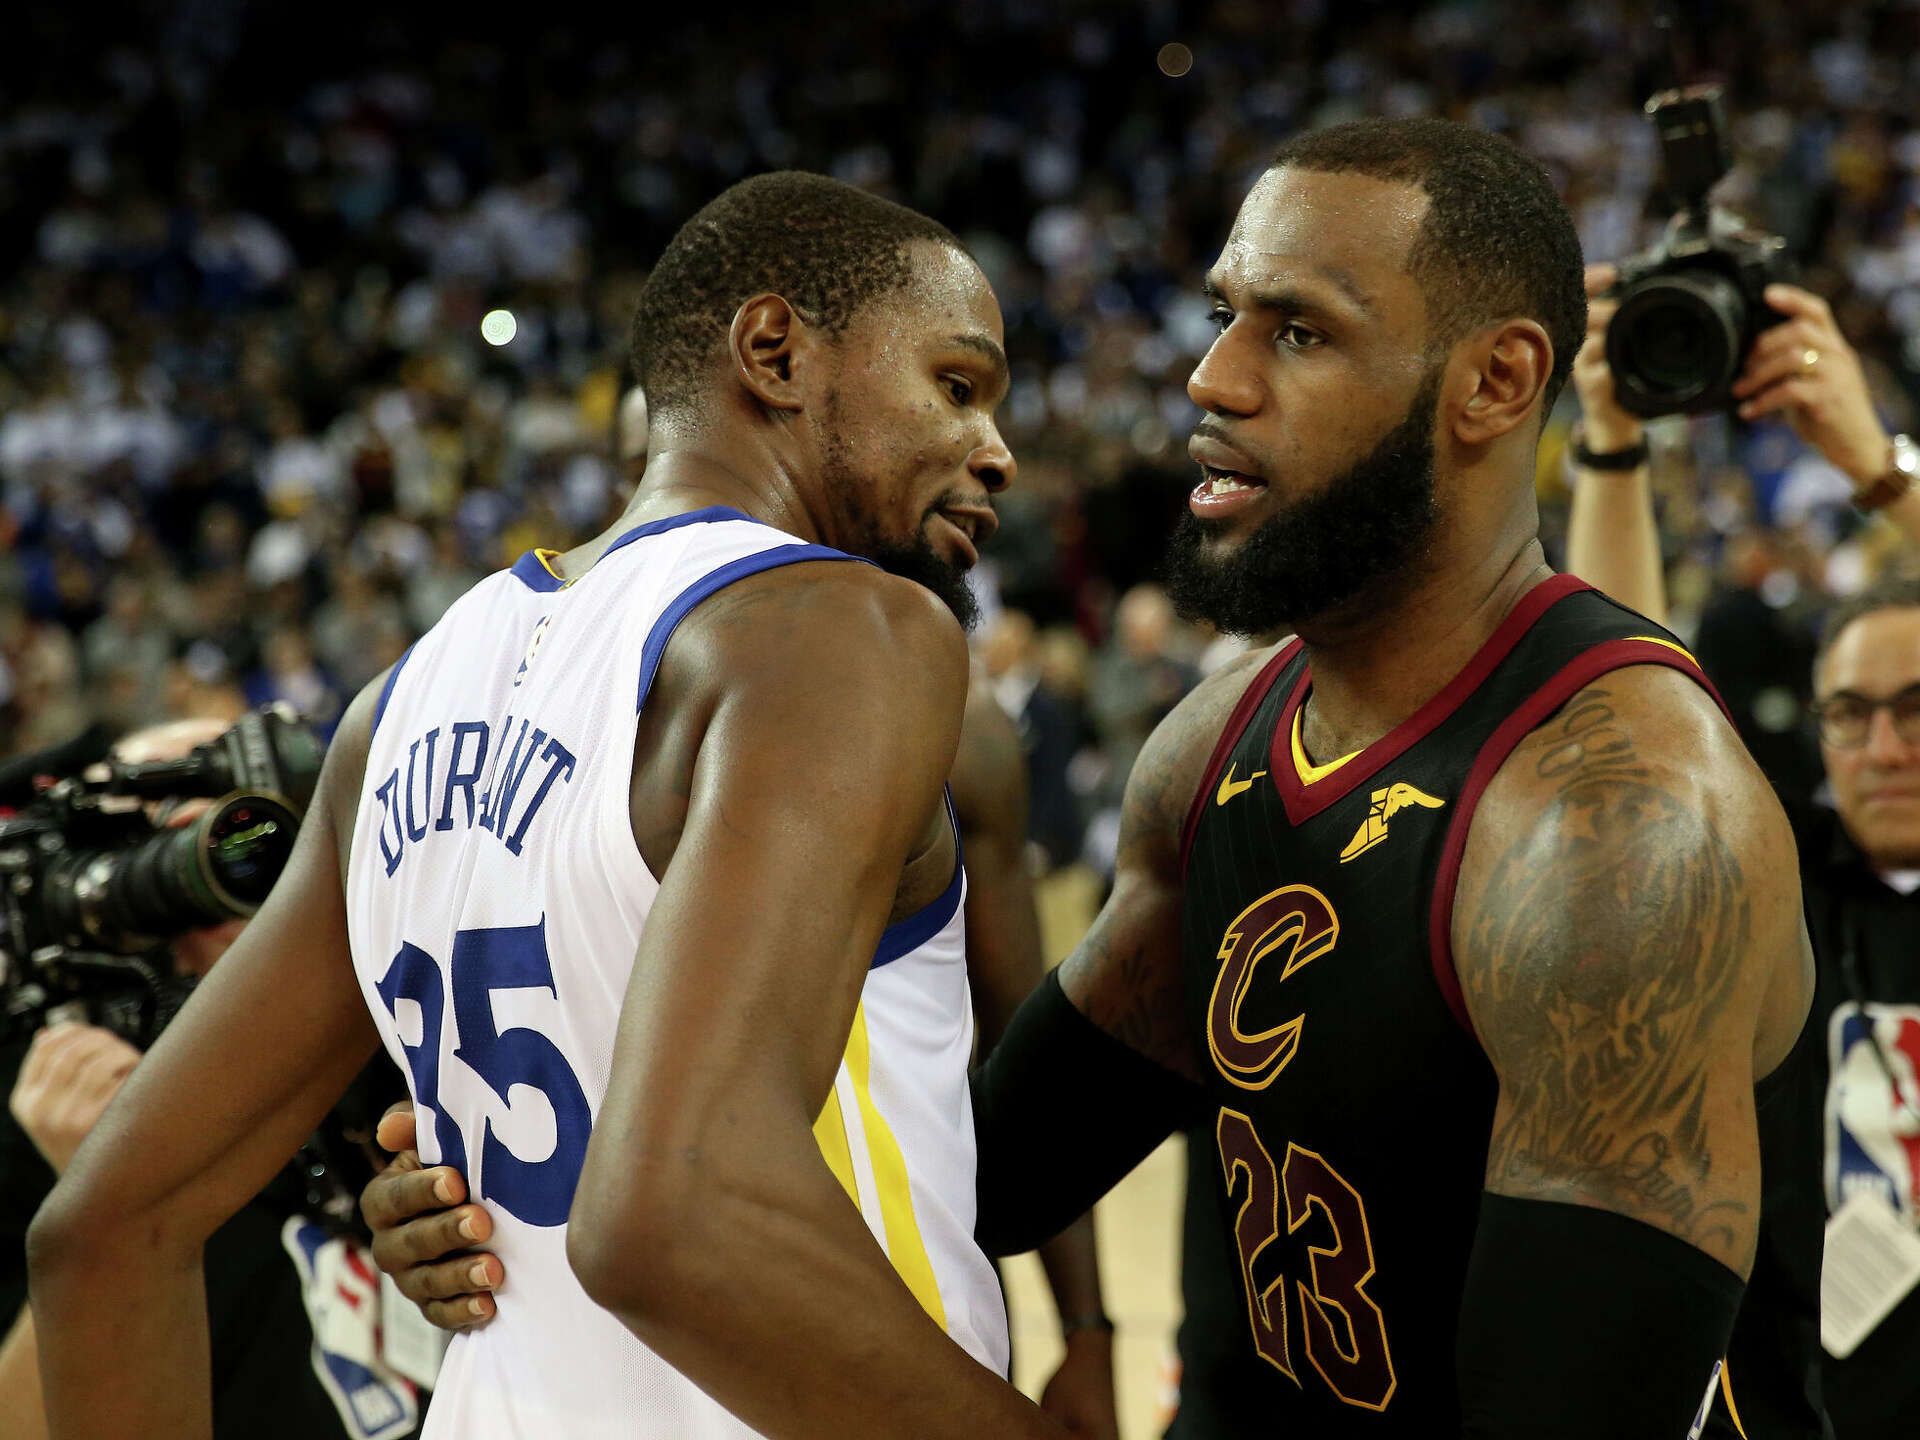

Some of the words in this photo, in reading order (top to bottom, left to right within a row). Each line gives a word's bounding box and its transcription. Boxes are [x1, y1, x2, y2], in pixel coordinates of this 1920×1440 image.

[375, 715, 577, 878] DURANT
[375, 911, 593, 1227] 35
[1206, 883, 1340, 1091] C
[1216, 1106, 1398, 1411] 23
